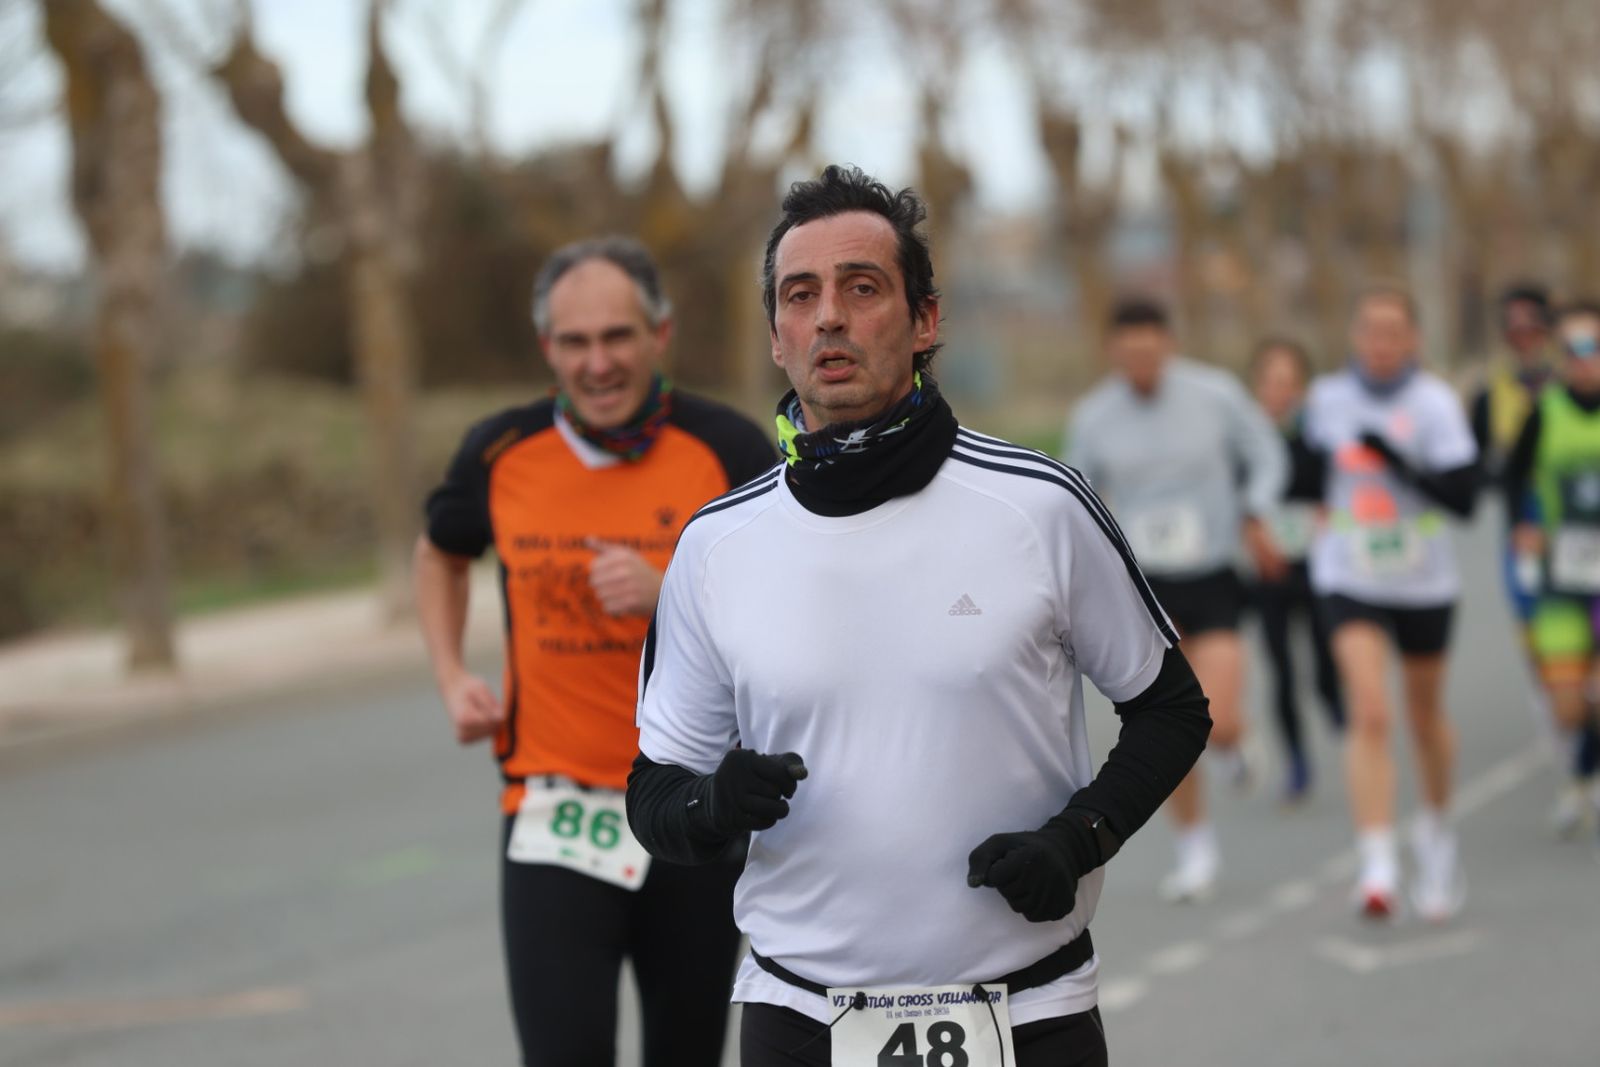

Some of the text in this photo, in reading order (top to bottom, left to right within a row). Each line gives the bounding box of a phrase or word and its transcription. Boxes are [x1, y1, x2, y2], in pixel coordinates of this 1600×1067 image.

[948, 607, 982, 616] adidas
[551, 799, 621, 850] 86
[833, 995, 846, 1007] VI
[849, 993, 894, 1009] DATLÓN
[898, 993, 933, 1007] CROSS
[877, 1021, 969, 1067] 48
